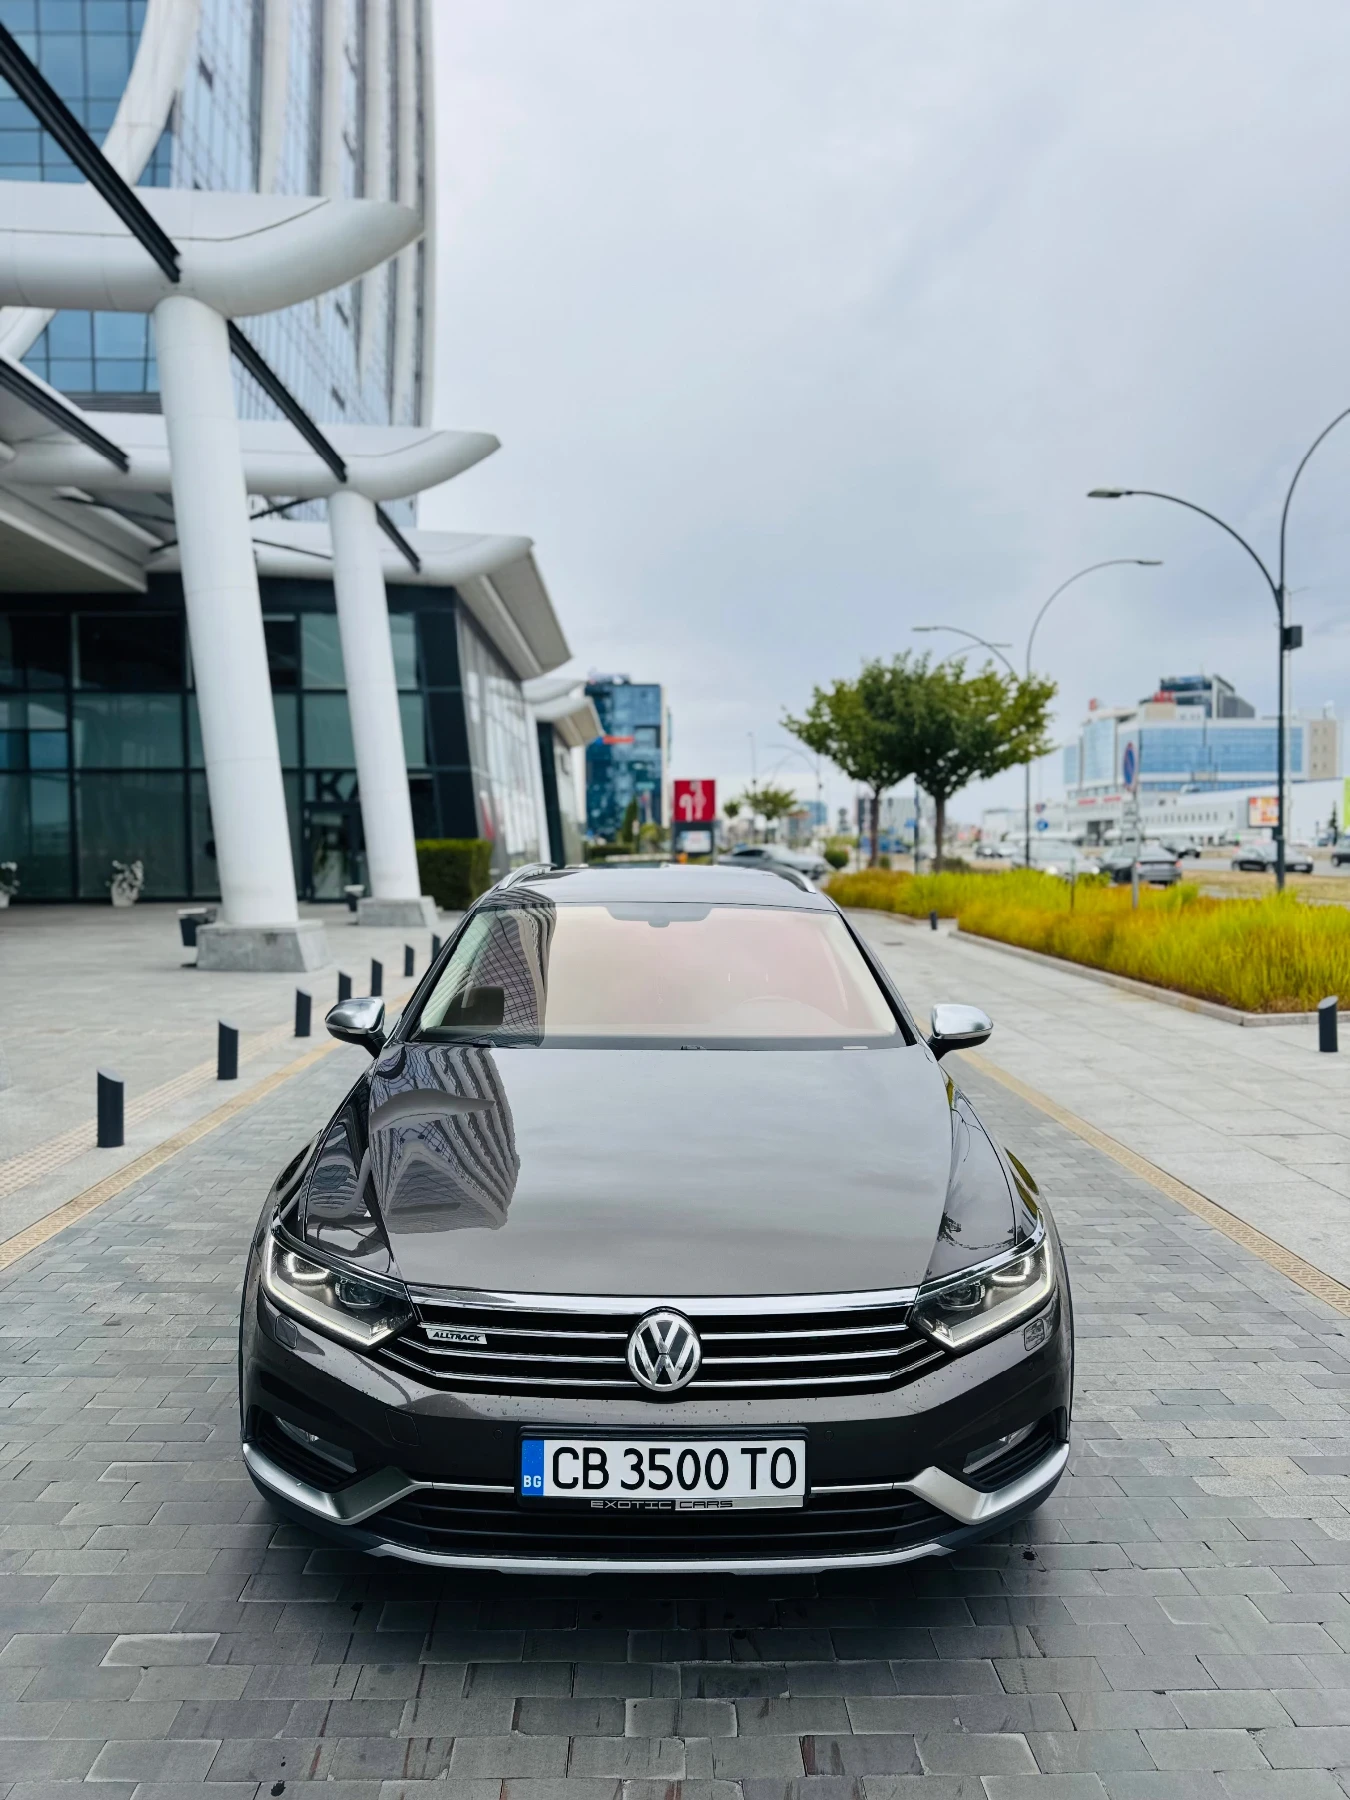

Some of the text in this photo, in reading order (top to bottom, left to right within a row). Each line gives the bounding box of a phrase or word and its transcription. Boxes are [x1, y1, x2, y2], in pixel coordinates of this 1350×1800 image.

[432, 1331, 481, 1342] ALLTRACK
[552, 1446, 797, 1491] CB 3500 TO
[523, 1475, 542, 1488] BG
[590, 1499, 734, 1510] EXOTIC CARS
